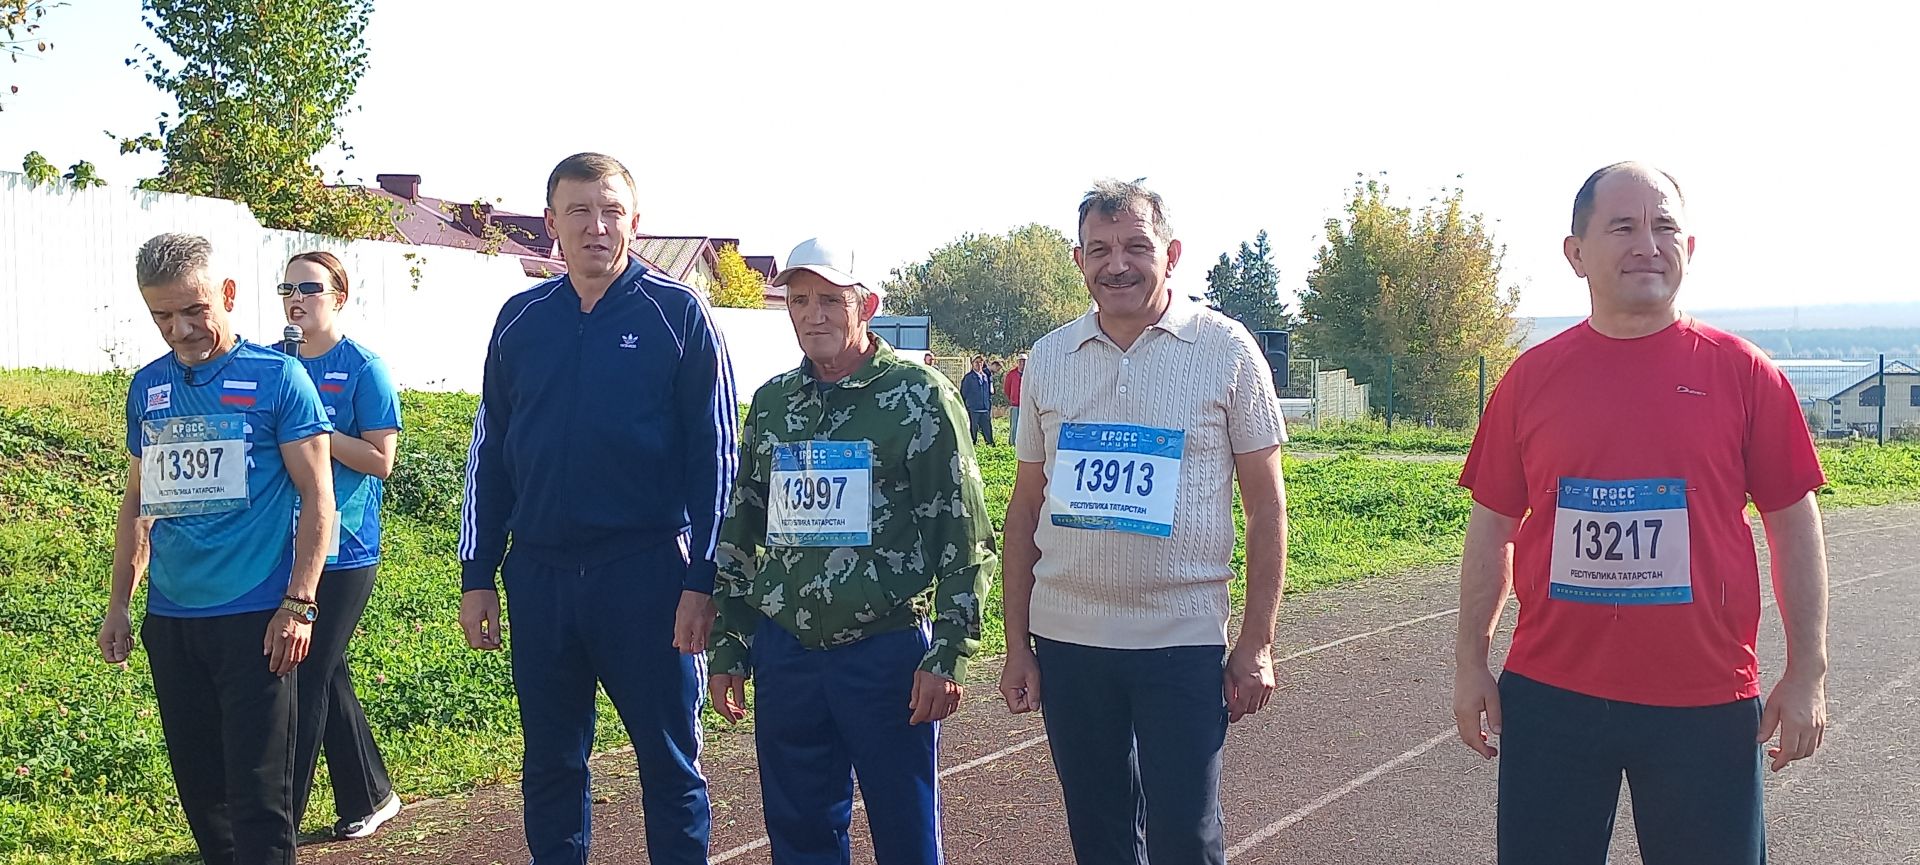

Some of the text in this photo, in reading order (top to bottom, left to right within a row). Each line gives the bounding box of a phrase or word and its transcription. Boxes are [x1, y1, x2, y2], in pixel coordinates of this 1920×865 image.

[172, 422, 205, 433] КРОСС
[1101, 430, 1138, 443] КРОСС
[157, 447, 223, 481] 13397
[1074, 458, 1154, 496] 13913
[783, 477, 847, 510] 13997
[1592, 487, 1635, 500] КРОСС
[1070, 501, 1147, 514] РЕСПУБЛИКА ТАТАРСТАН
[811, 518, 845, 526] ТАТАРСТАН
[1573, 519, 1662, 561] 13217
[1570, 569, 1663, 580] РЕСПУБЛИКА ТАТАРСТАН
